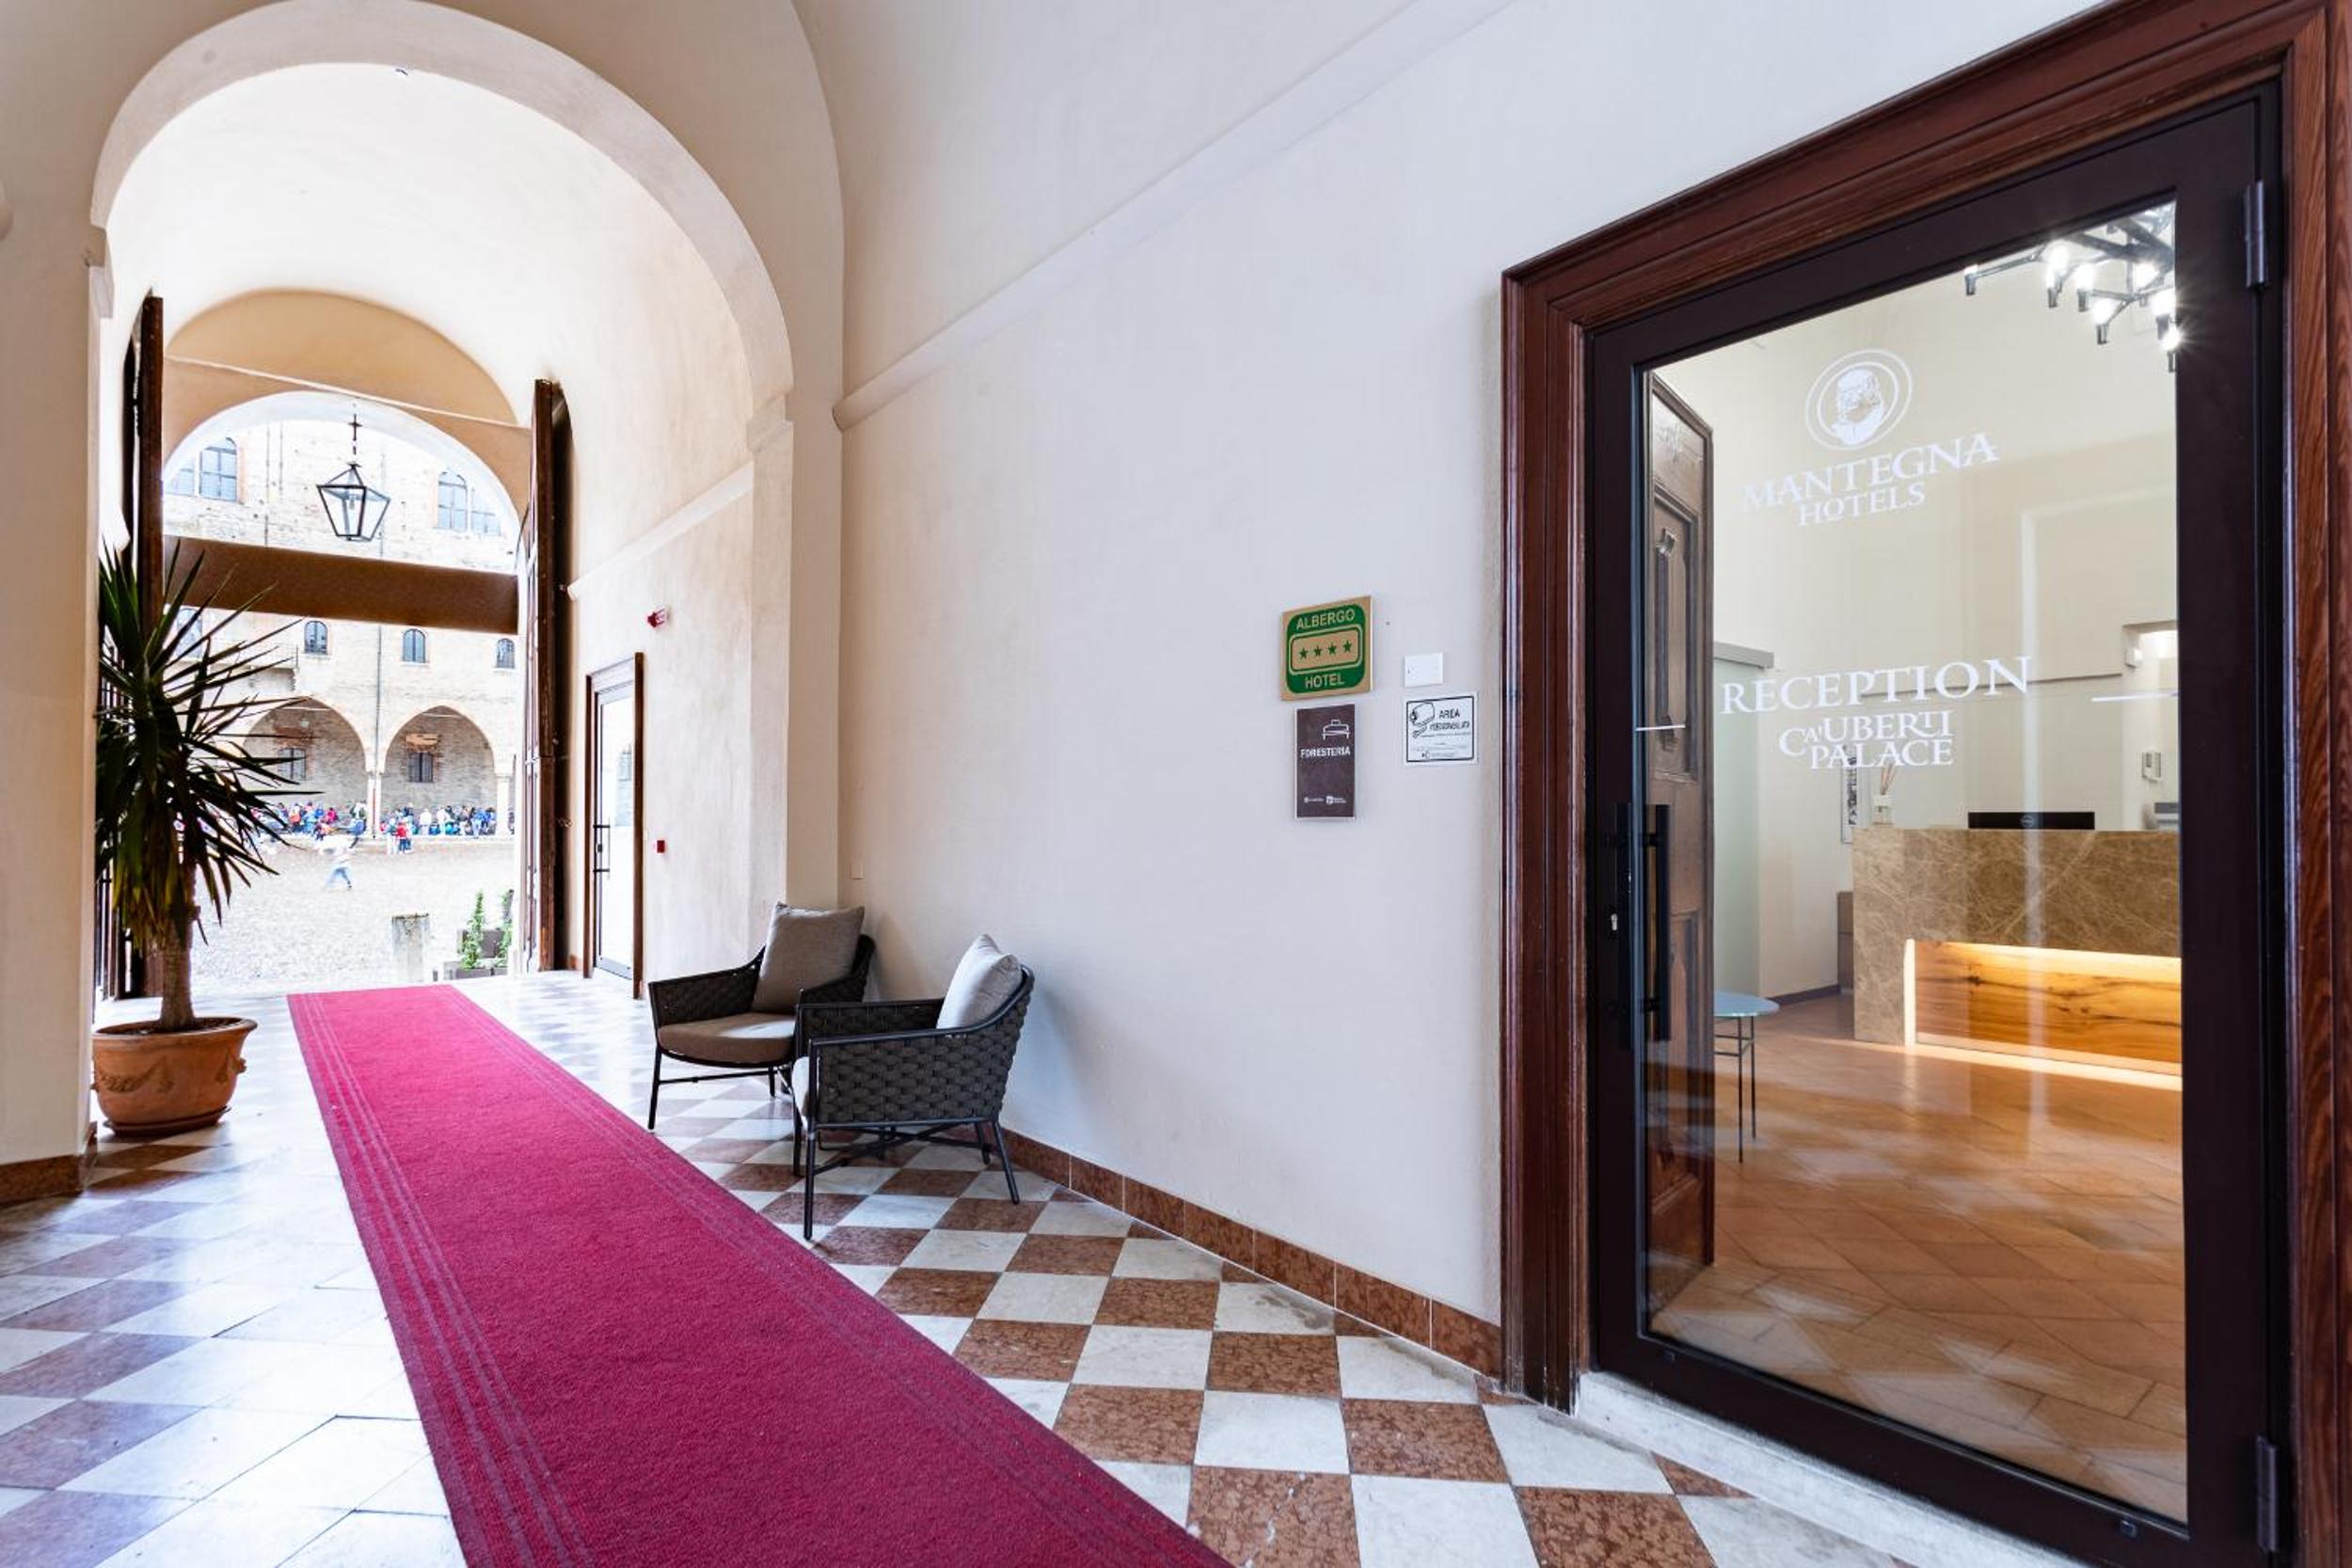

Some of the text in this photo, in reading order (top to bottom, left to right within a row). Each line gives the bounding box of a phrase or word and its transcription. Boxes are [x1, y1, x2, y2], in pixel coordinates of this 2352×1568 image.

[1742, 433, 1999, 511] MANTEGNA
[1798, 483, 1925, 526] HOTELS
[1296, 610, 1355, 629] ALBERGO
[1306, 673, 1344, 689] HOTEL
[1720, 656, 2031, 714] RECEPTION
[1438, 708, 1460, 720] AREA
[1300, 746, 1351, 759] FORESTERIA
[1810, 739, 1954, 768] PALACE
